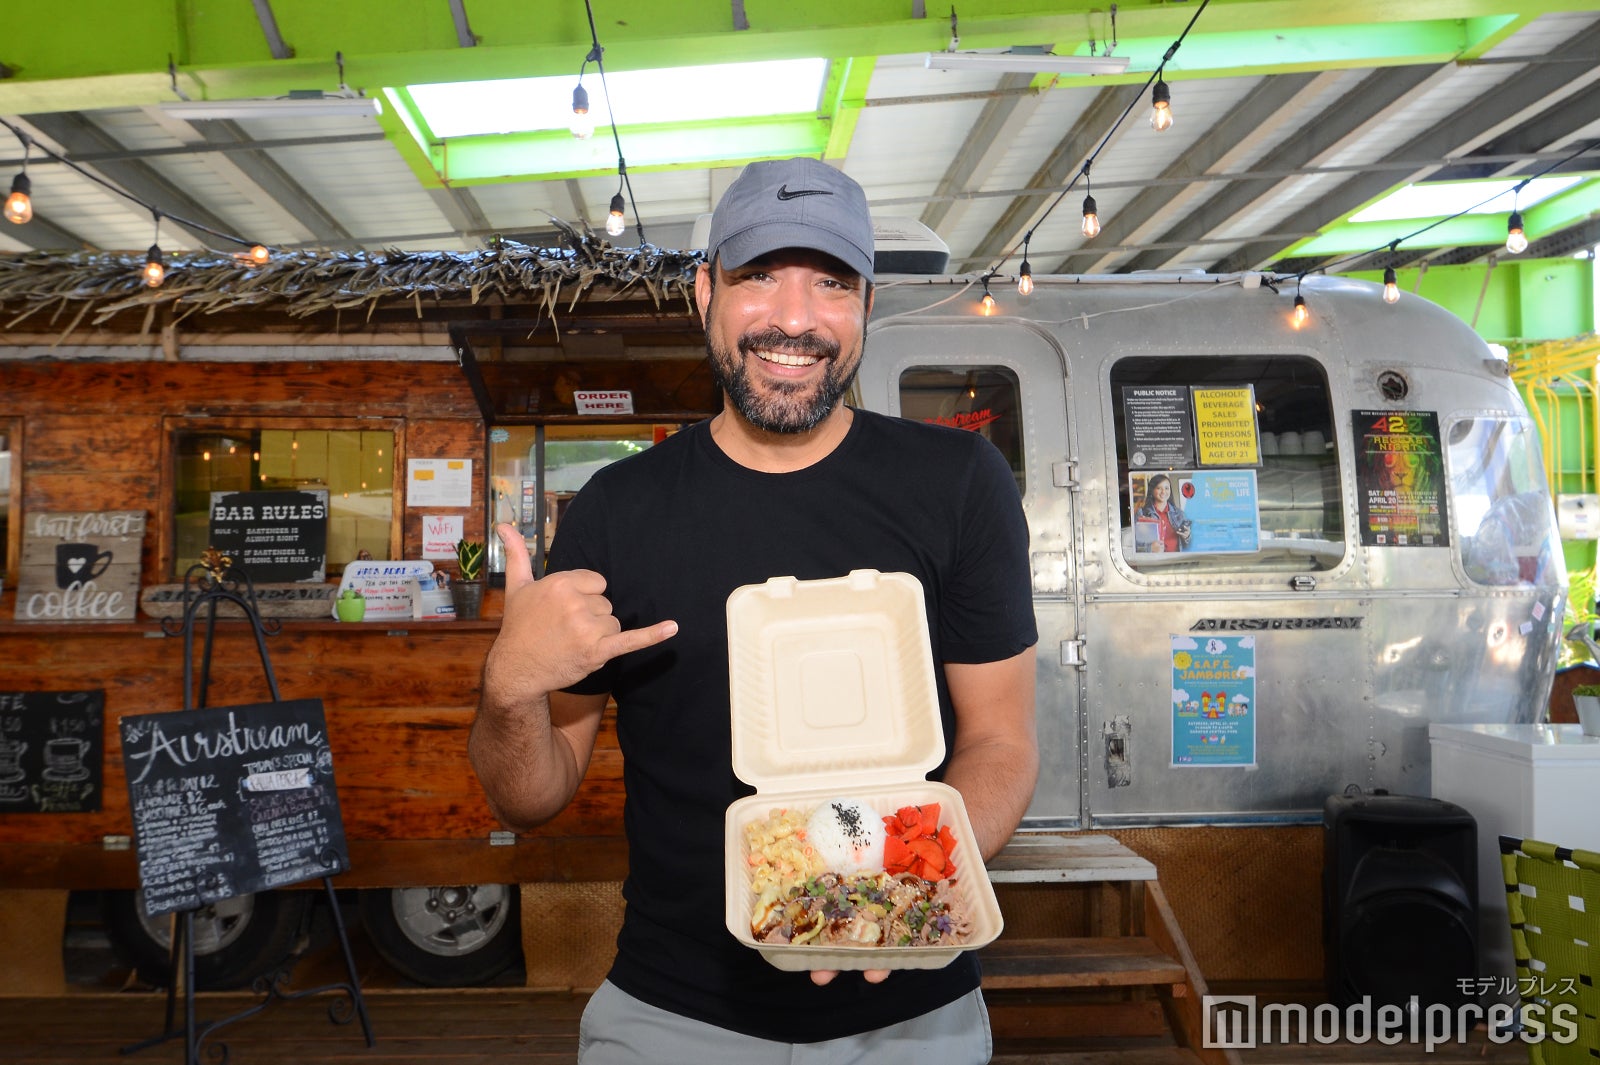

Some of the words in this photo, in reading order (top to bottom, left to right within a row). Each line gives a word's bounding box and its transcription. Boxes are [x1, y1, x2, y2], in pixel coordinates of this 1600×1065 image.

[1200, 391, 1246, 399] ALCOHOLIC
[1203, 401, 1244, 409] BEVERAGE
[1373, 436, 1423, 444] REGGAE
[1205, 441, 1234, 449] UNDER
[1380, 443, 1417, 451] NIGHT
[214, 506, 255, 521] BAR
[262, 505, 324, 520] RULES
[26, 580, 126, 618] coffee
[1189, 616, 1364, 631] AIRSTREAM
[1179, 670, 1247, 680] JAMBOREE
[130, 711, 321, 784] Airstream
